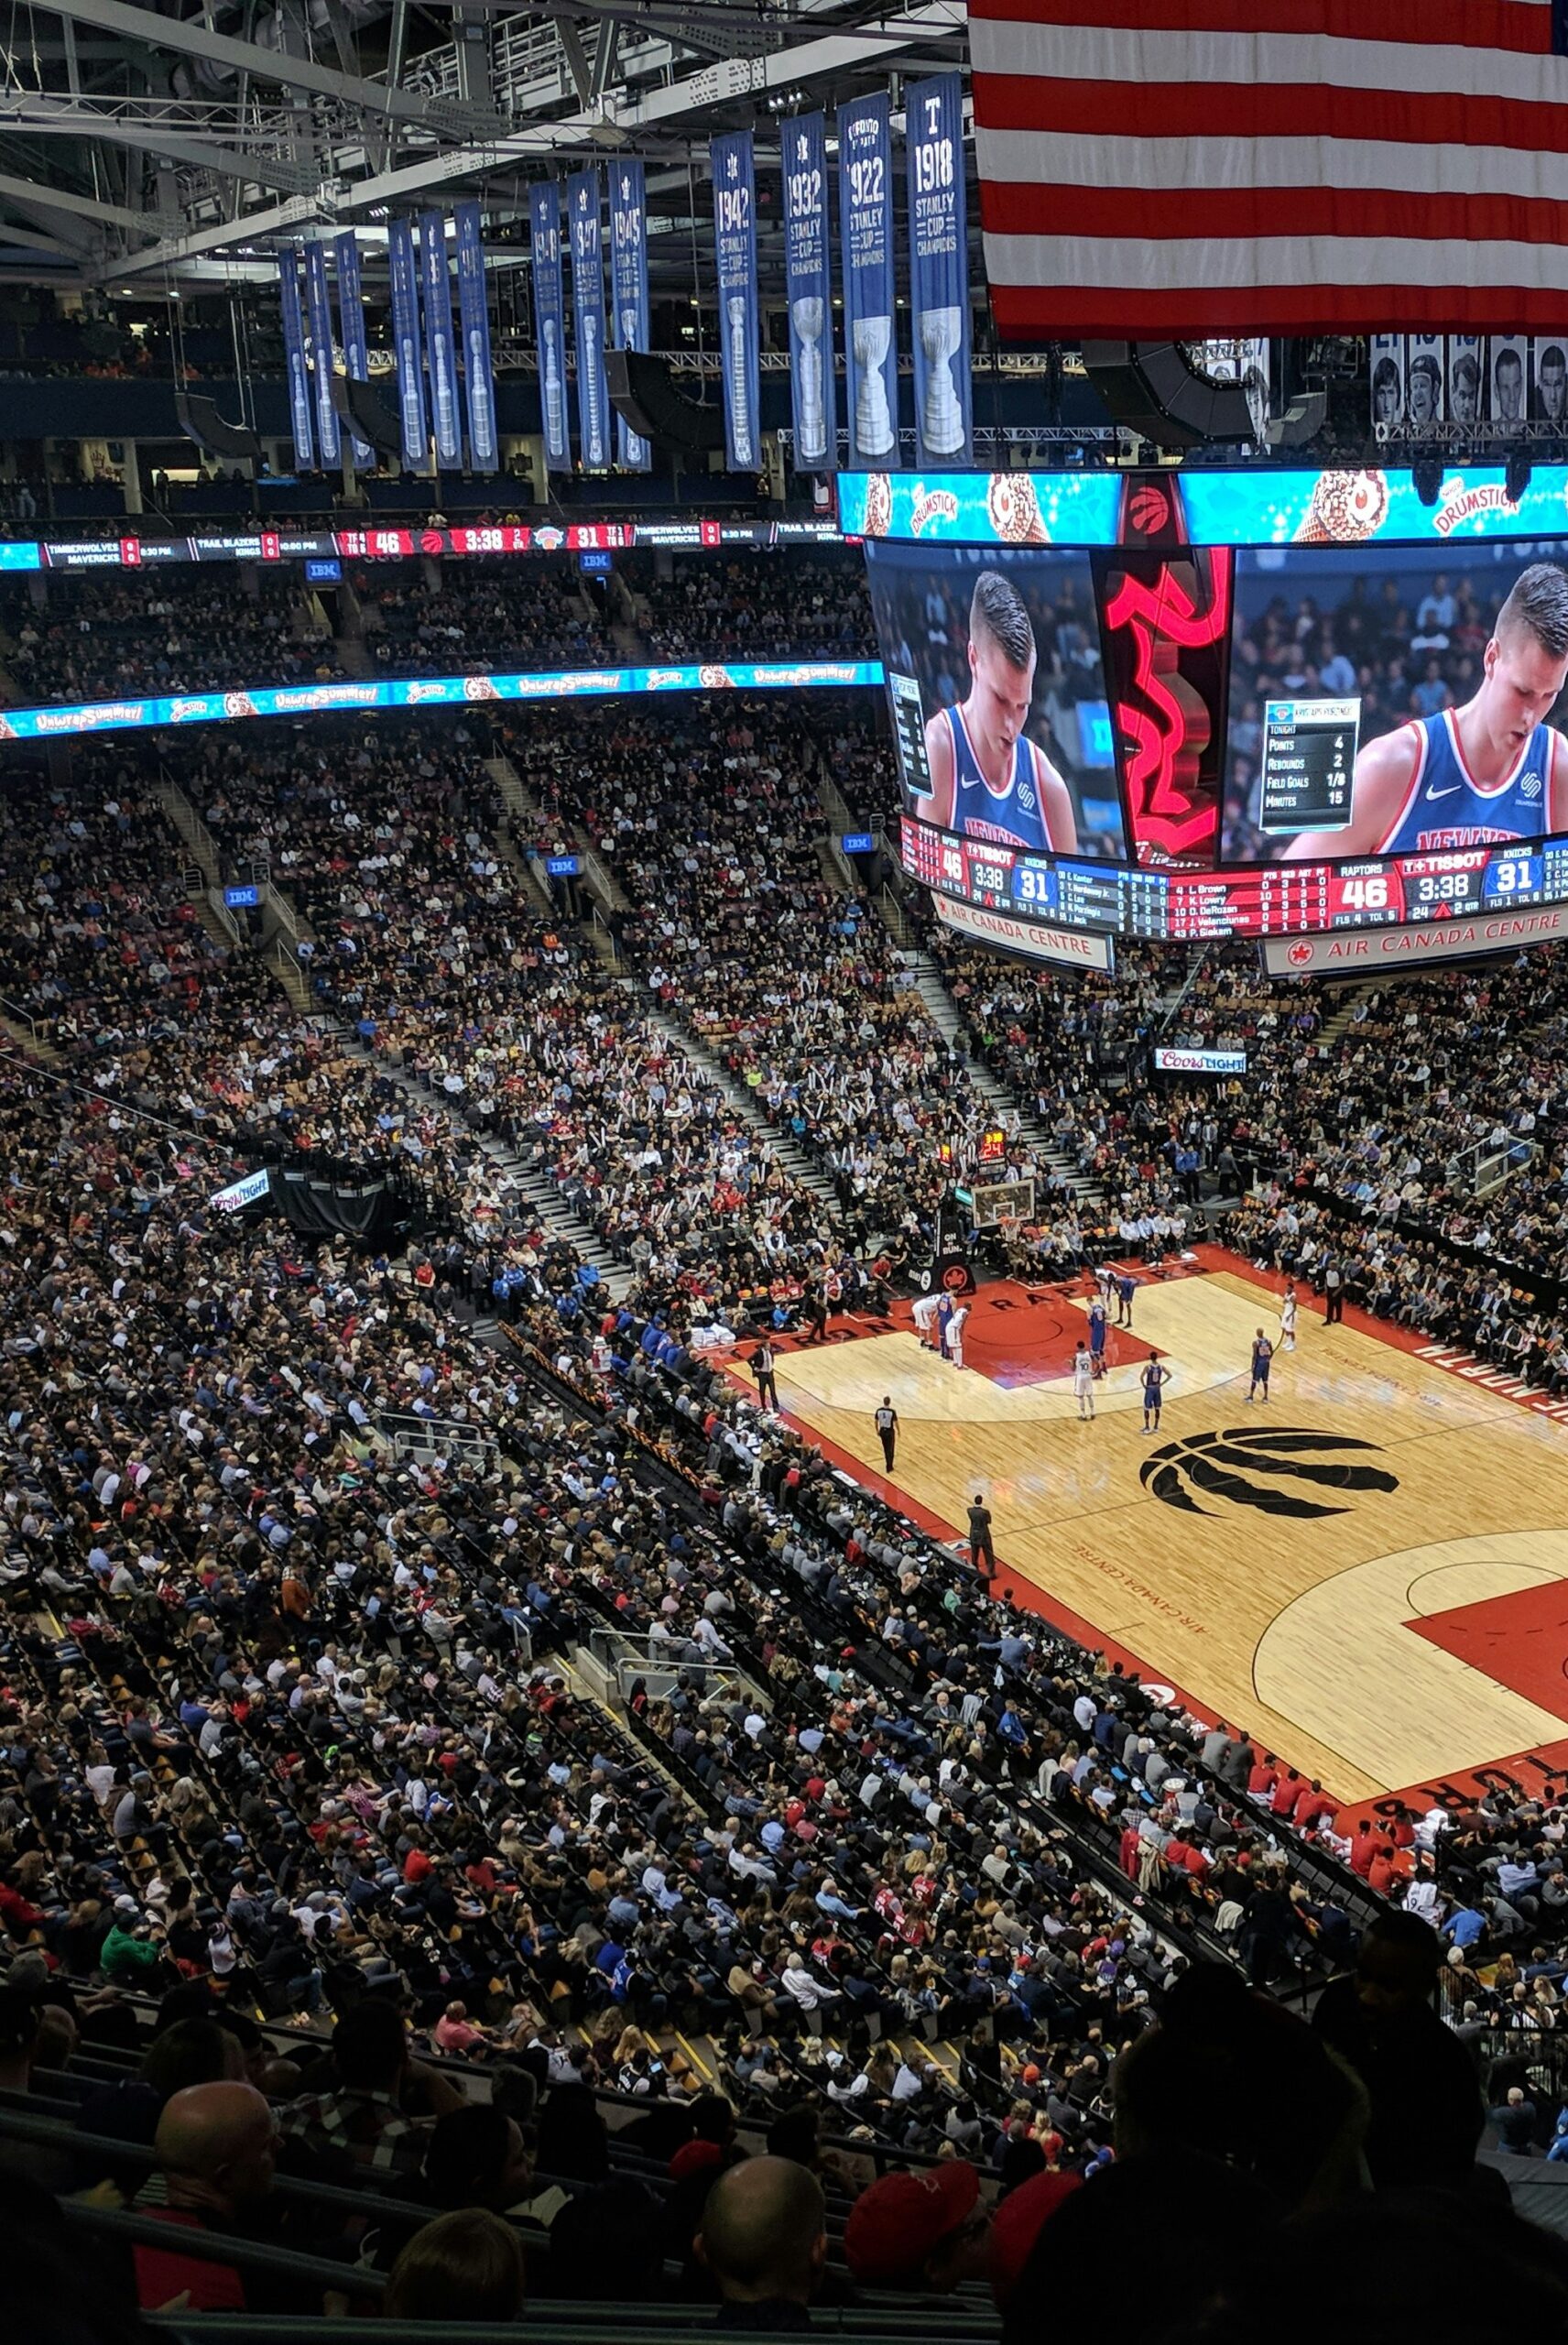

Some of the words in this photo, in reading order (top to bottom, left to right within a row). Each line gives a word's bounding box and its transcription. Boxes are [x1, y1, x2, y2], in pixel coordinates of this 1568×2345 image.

[916, 138, 953, 192] 1918
[846, 157, 884, 206] 922
[718, 187, 748, 232] 1942
[916, 192, 954, 218] STANLEY
[928, 216, 944, 237] CUP
[911, 494, 955, 533] DRUMSTICK
[636, 525, 700, 534] TIMBERWOLVES
[198, 539, 221, 549] TRAIL
[223, 538, 260, 548] BLAZERS
[267, 536, 273, 546] 0
[376, 532, 399, 553] 46
[465, 529, 502, 550] 3:38
[578, 528, 598, 547] 31
[49, 543, 119, 554] TIMBERWOLVES
[126, 542, 134, 551] 0
[158, 547, 171, 556] PM
[267, 547, 274, 556] 0
[303, 541, 318, 550] PM
[68, 554, 120, 564] MAVERICKS
[235, 548, 261, 557] KINGS
[583, 555, 609, 566] IBM
[310, 564, 336, 576] IBM
[1270, 725, 1296, 734] TONIGHT
[1334, 736, 1344, 748] 4
[1334, 755, 1343, 768] 2
[1329, 791, 1344, 804] 15
[847, 838, 867, 848] IBM
[1504, 846, 1532, 859] KNICKS
[551, 861, 574, 873] IBM
[942, 849, 963, 880] 46
[1426, 851, 1485, 871] TISSOT
[975, 864, 1003, 890] 3:38
[1341, 864, 1382, 877] RAPTORS
[1497, 861, 1531, 892] 31
[1021, 870, 1049, 901] 31
[1176, 887, 1183, 895] 4
[1198, 885, 1226, 894] Brown
[1262, 880, 1269, 889] 0
[1301, 878, 1306, 887] 1
[1319, 877, 1325, 886] 0
[1419, 874, 1468, 900] 3:38
[230, 890, 253, 903] IBM
[1145, 895, 1150, 904] 0
[1177, 897, 1182, 905] 7
[1200, 897, 1225, 905] Lowry
[1260, 891, 1271, 900] 10
[1319, 887, 1325, 896] 0
[1341, 878, 1388, 910] 46
[1174, 908, 1186, 917] 10
[1200, 906, 1237, 915] DeRozan
[1319, 898, 1325, 907] 0
[1454, 901, 1462, 914] 2
[1465, 901, 1479, 912] QTR
[1490, 899, 1502, 907] FLS
[1506, 896, 1511, 905] 1
[1118, 901, 1124, 910] 0
[1160, 908, 1165, 916] 1
[1412, 907, 1428, 919] 24
[1145, 916, 1151, 924] 0
[1160, 918, 1165, 926] 1
[1175, 918, 1185, 927] 17
[1262, 912, 1269, 922] 0
[1301, 910, 1306, 919] 1
[1319, 908, 1325, 917] 0
[1336, 916, 1349, 924] FLS
[1355, 914, 1361, 923] 4
[1388, 911, 1395, 921] 5
[952, 905, 967, 920] AIR
[972, 912, 1026, 941] CANADA
[1029, 928, 1093, 956] CENTRE
[1133, 925, 1138, 933] 1
[1160, 929, 1166, 938] 0
[1282, 922, 1289, 931] 1
[1301, 920, 1307, 929] 0
[1319, 919, 1324, 928] 1
[1328, 940, 1369, 958] AIR
[1380, 926, 1475, 953] CANADA
[1484, 912, 1562, 939] CENTRE
[1162, 1051, 1203, 1069] Coors
[1204, 1056, 1244, 1070] LIGHT
[984, 1143, 1001, 1157] 24
[239, 1179, 266, 1201] LIGHT
[1080, 1362, 1089, 1370] 10
[1073, 1545, 1126, 1579] CENTRE
[1124, 1578, 1181, 1618] CANADA
[1180, 1615, 1209, 1634] AIR
